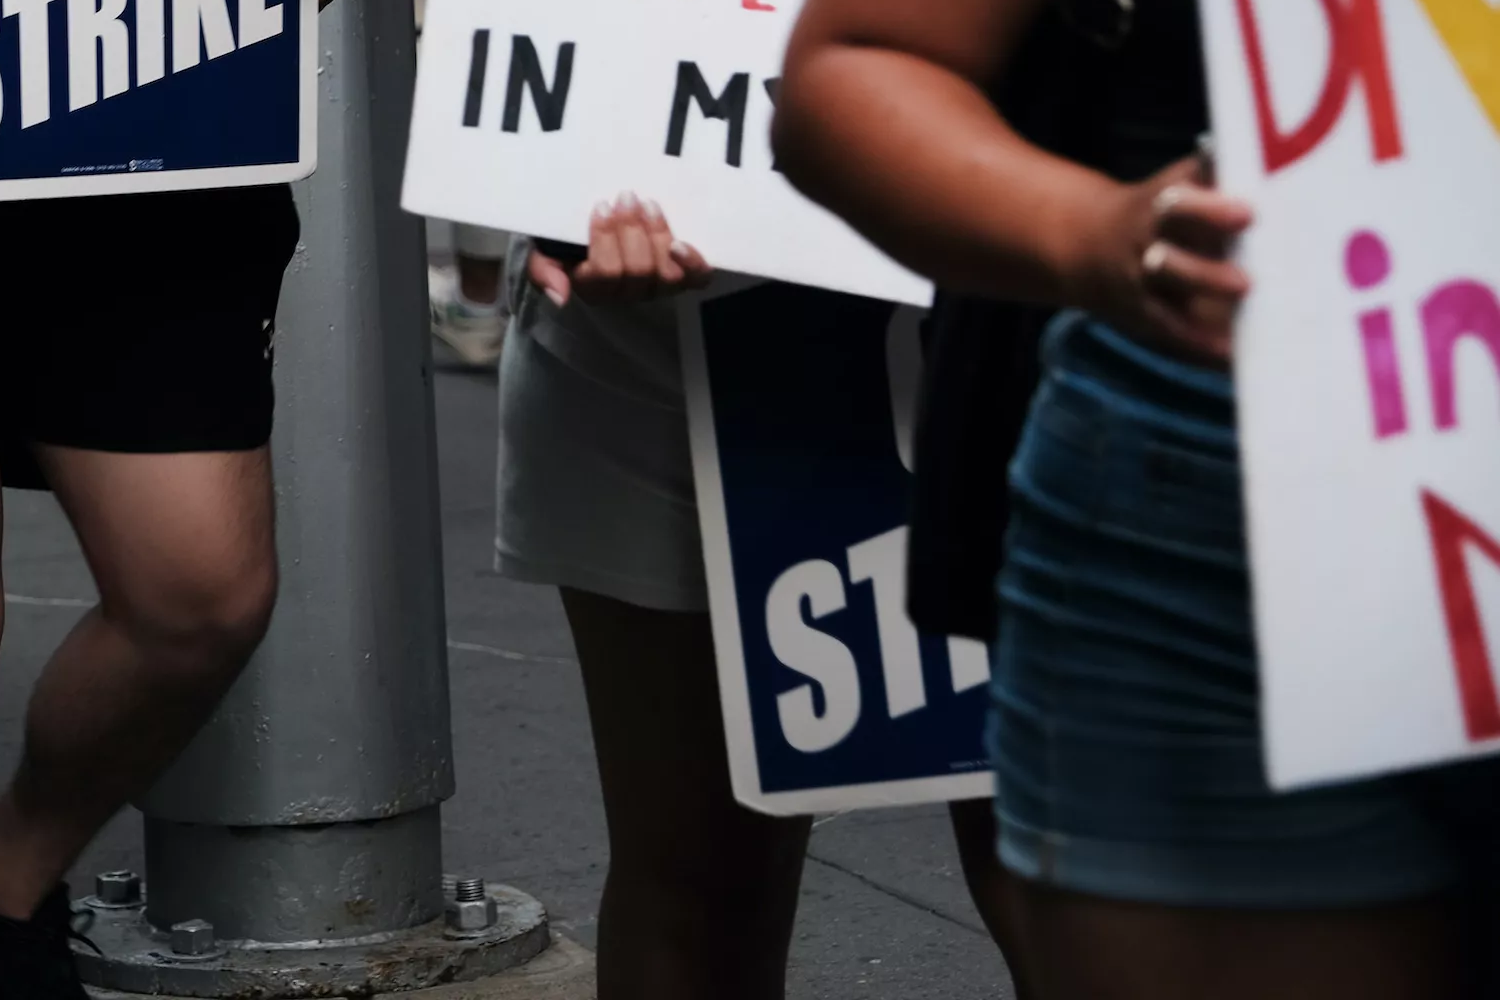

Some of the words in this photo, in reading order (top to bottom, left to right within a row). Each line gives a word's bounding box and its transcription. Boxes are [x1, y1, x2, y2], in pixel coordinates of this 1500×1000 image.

[461, 29, 575, 132] IN
[664, 60, 783, 172] M
[765, 525, 990, 753] ST
